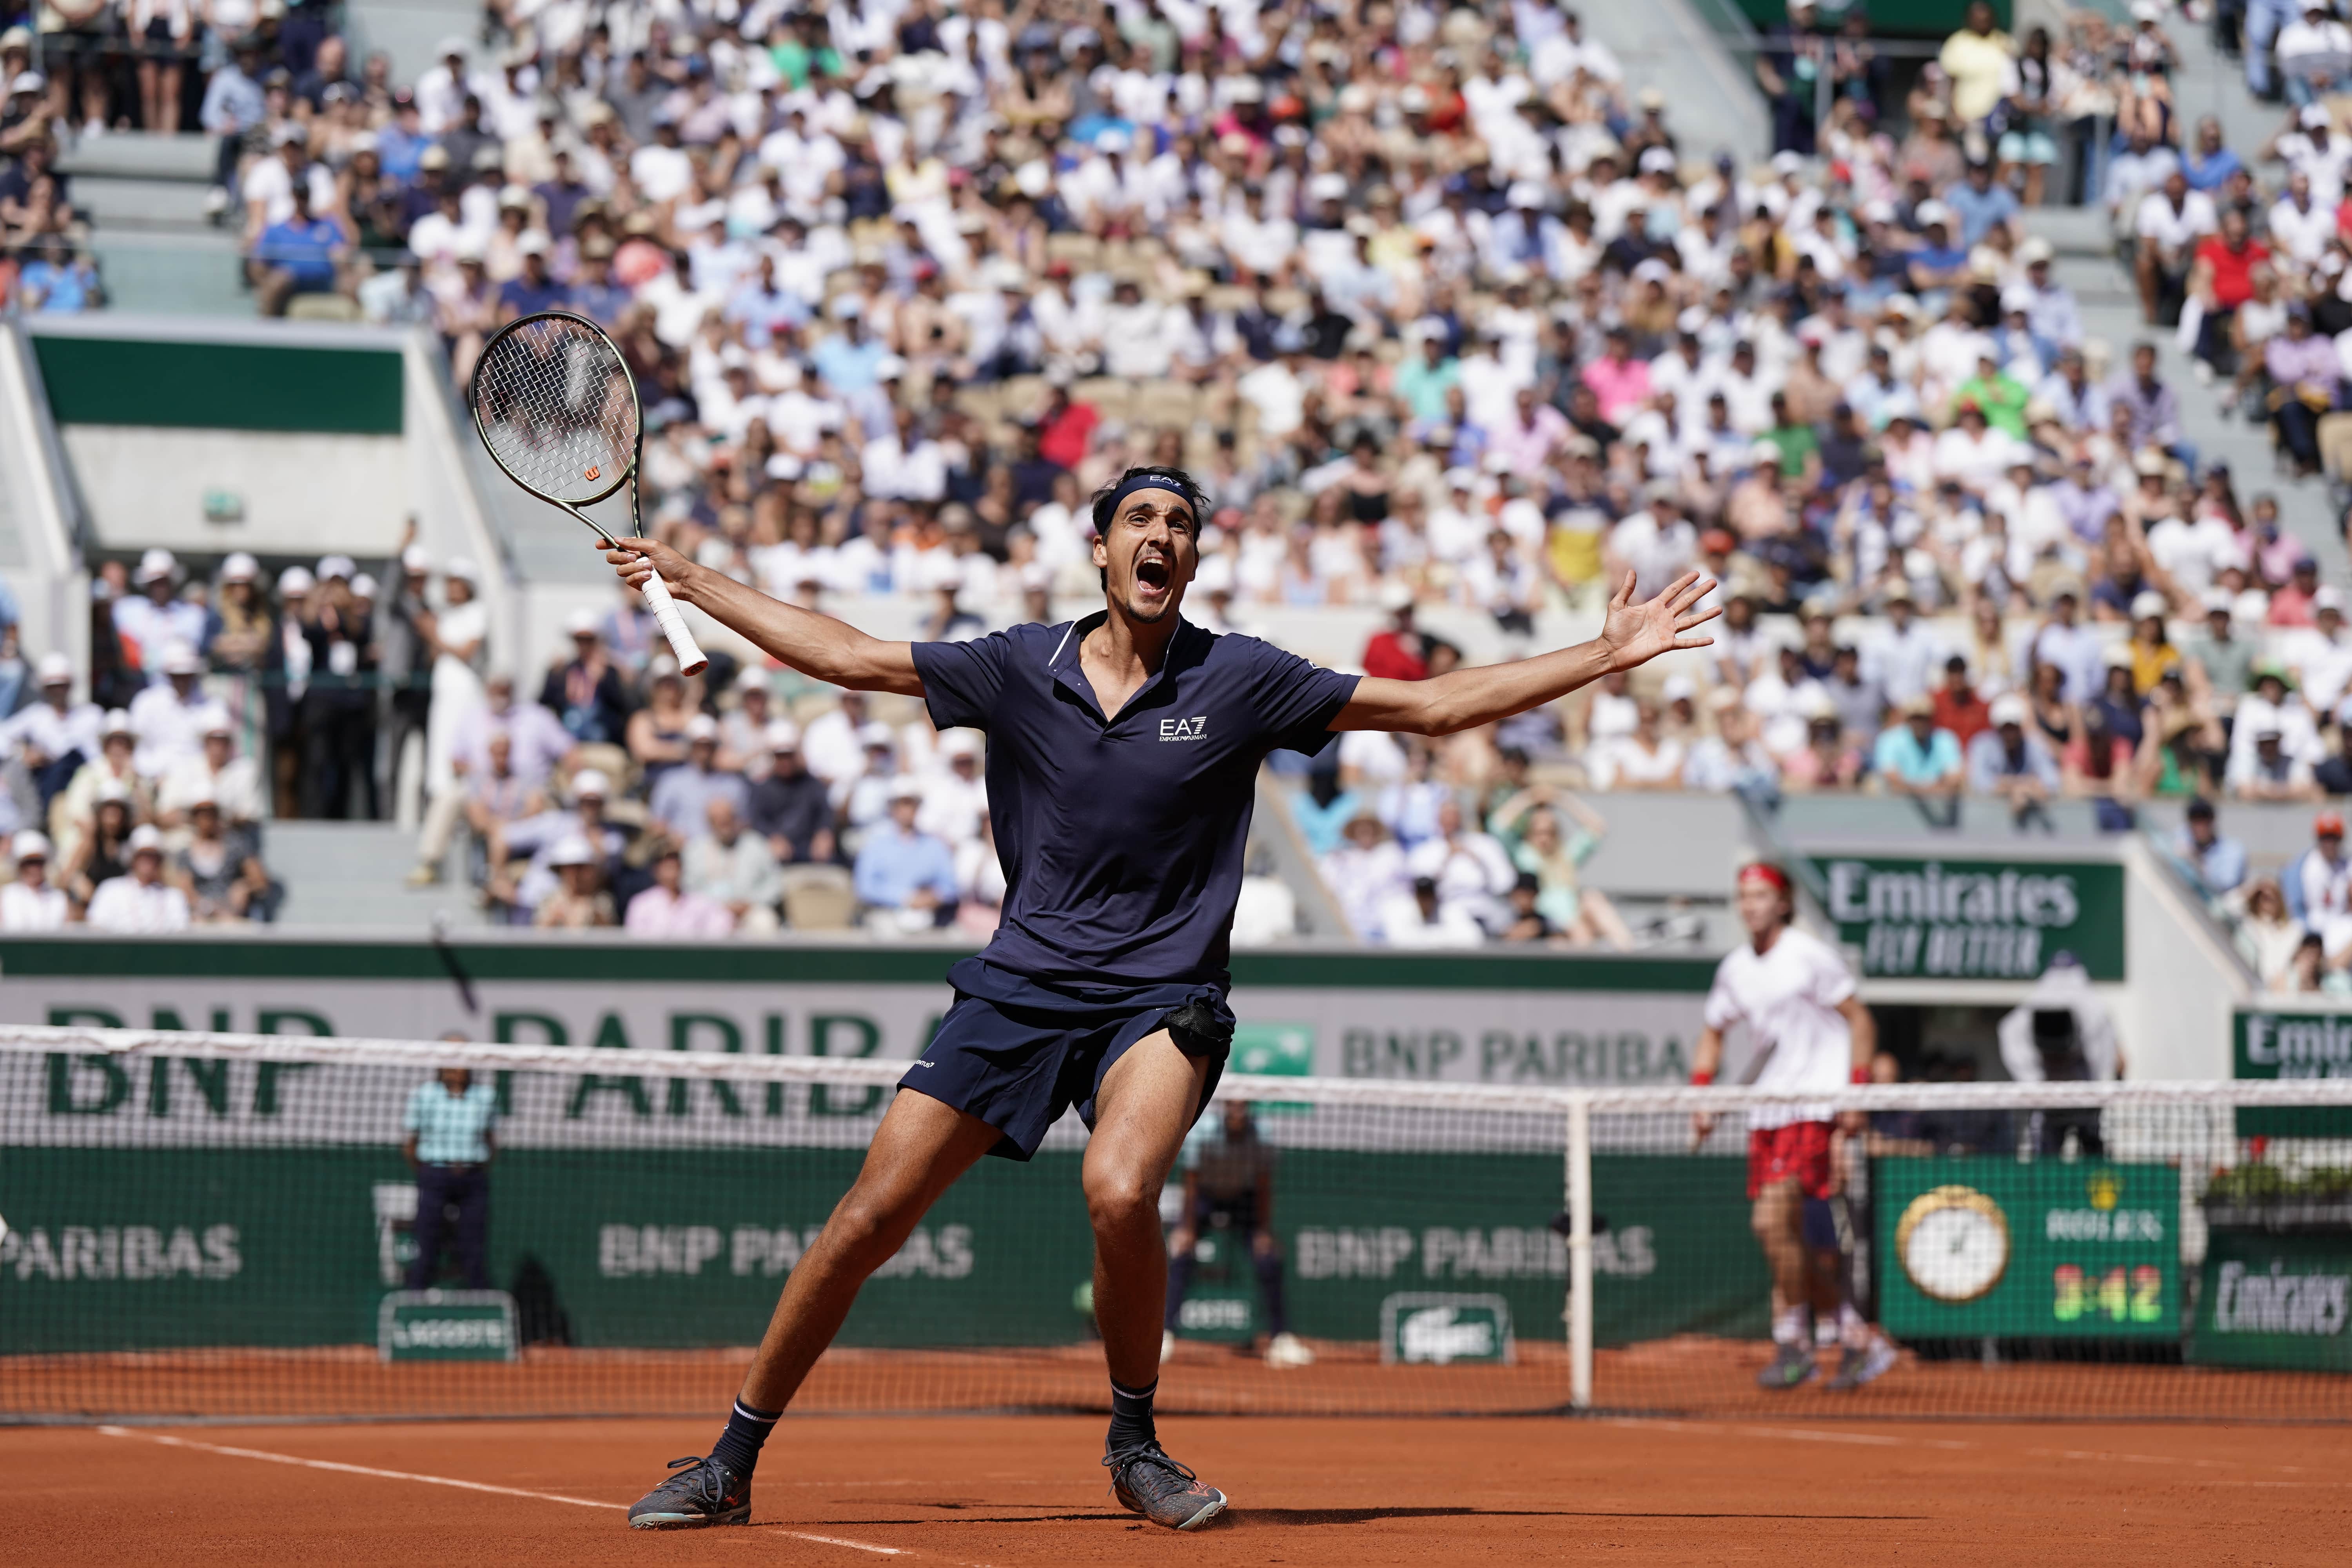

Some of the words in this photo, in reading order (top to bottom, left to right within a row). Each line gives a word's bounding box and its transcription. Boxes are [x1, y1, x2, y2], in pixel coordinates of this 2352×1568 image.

[1150, 475, 1181, 486] EA7
[1160, 716, 1207, 735] EA7
[1828, 860, 2079, 927] Emirates
[46, 1005, 337, 1118] BNP
[493, 1008, 944, 1120] PARIB
[916, 1060, 935, 1068] ENTUS7
[1342, 1026, 1463, 1080] BNP
[1479, 1031, 1725, 1085] PARIBA
[599, 1224, 722, 1278] BNP
[731, 1223, 975, 1279] PAAS
[2046, 1208, 2164, 1241] ROLEX
[1297, 1226, 1414, 1279] BNP
